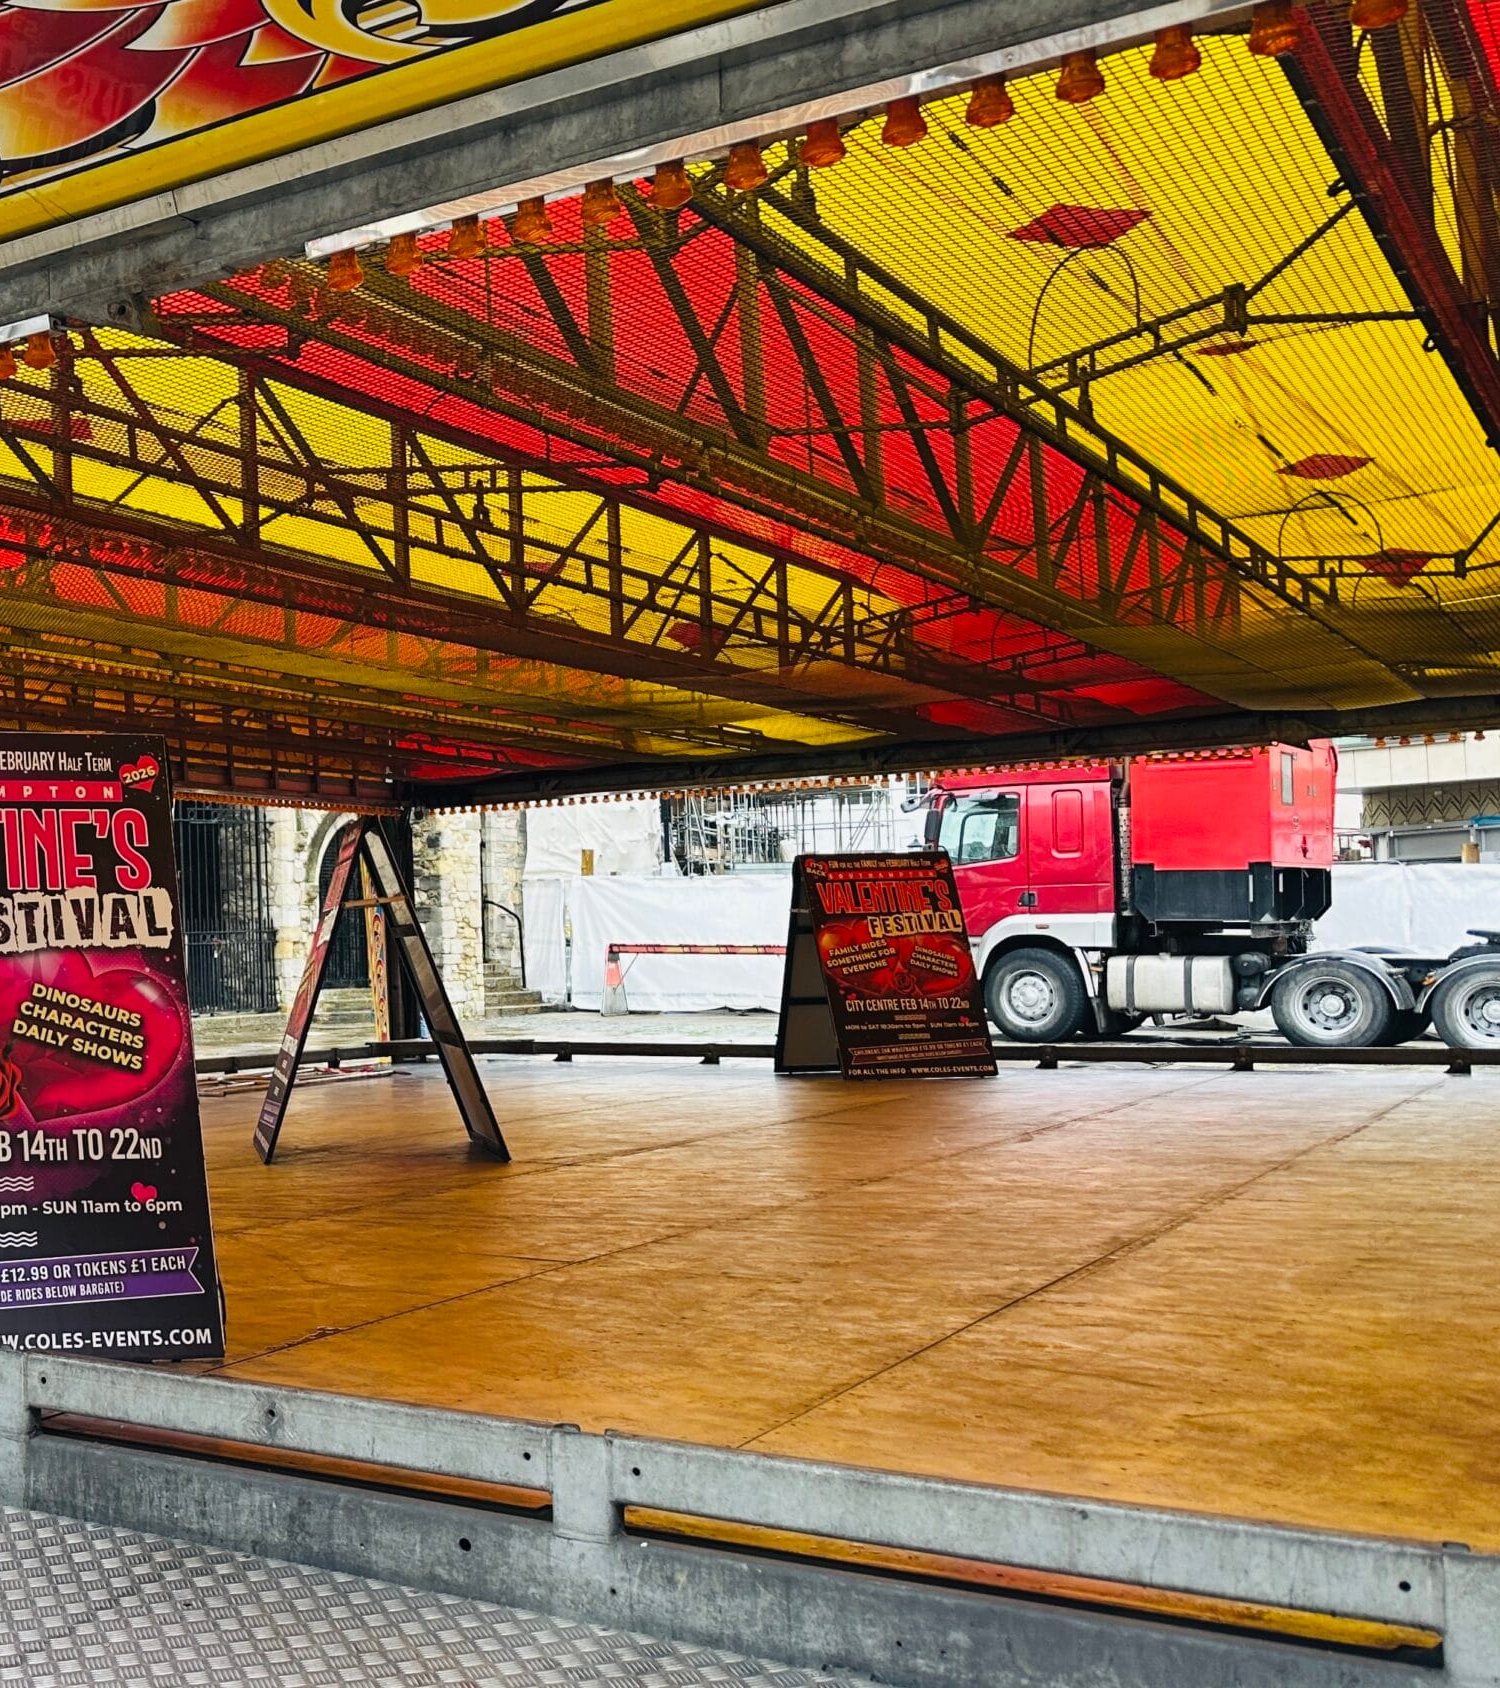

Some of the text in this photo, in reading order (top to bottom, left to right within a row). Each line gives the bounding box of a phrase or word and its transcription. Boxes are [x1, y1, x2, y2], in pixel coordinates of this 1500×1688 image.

[122, 766, 157, 784] 2026
[816, 879, 952, 914] VALENTINE'S
[868, 911, 961, 936] FESTIVAL
[826, 948, 896, 968] SOMETHING FOR
[828, 939, 887, 957] FAMILY RIDES
[842, 959, 888, 975] EVERYONE
[910, 959, 931, 969] DAILY
[911, 952, 958, 970] CHARACTERS
[32, 982, 142, 1027] DINOSAURS
[845, 999, 865, 1012] CITY
[866, 999, 900, 1012] CENTRE
[900, 998, 917, 1010] FEB
[919, 998, 936, 1010] 14TH
[937, 997, 949, 1009] TO
[20, 1001, 145, 1049] CHARACTERS
[12, 1019, 143, 1070] DAILY SHOWS
[17, 1129, 68, 1162] 14TH
[72, 1128, 104, 1161] TO
[109, 1127, 163, 1161] 22ND
[42, 1200, 78, 1215] SUN
[81, 1200, 120, 1214] 11am
[123, 1199, 142, 1213] to
[145, 1199, 183, 1215] 6pm
[0, 1264, 49, 1283] £12.99
[52, 1263, 72, 1279] OR
[74, 1260, 127, 1278] TOKENS
[130, 1258, 147, 1274] £1
[151, 1255, 186, 1272] EACH
[15, 1286, 43, 1302] RIDES
[45, 1283, 78, 1299] BELOW
[80, 1280, 125, 1297] BARGATE)
